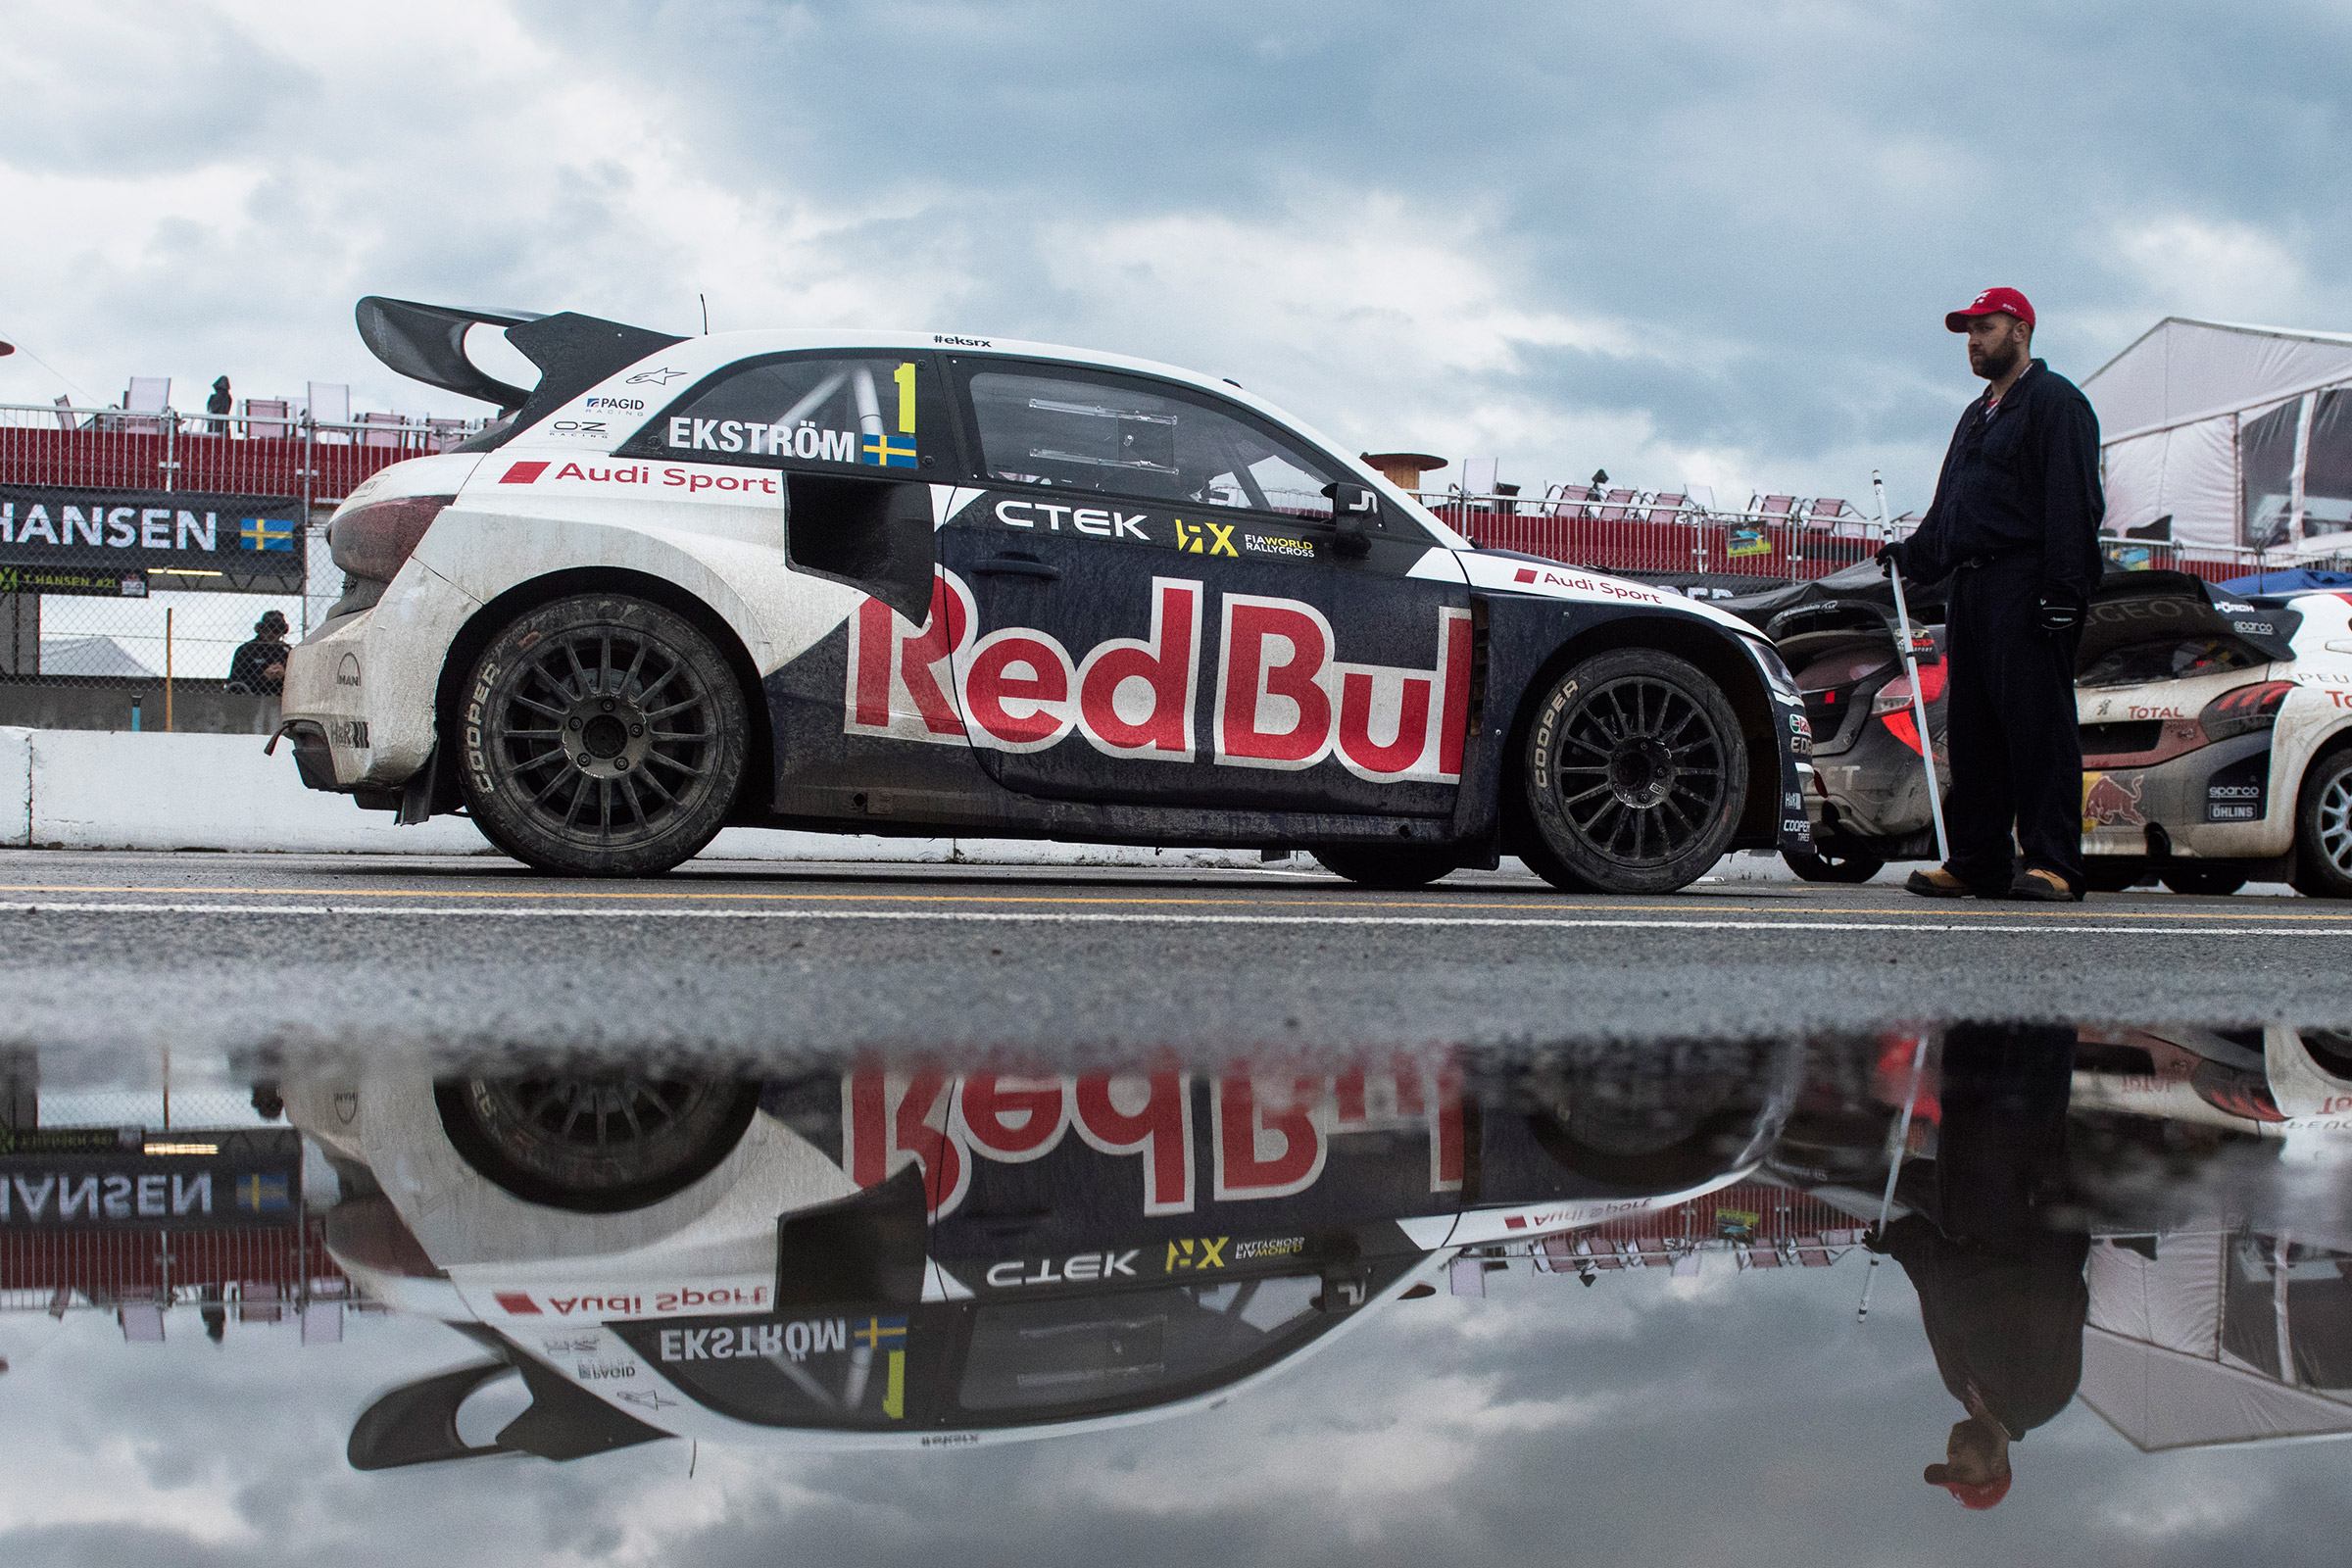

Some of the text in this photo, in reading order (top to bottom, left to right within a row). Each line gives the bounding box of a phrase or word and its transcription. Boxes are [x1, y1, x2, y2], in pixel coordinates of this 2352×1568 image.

[933, 335, 992, 347] #eksrx
[601, 398, 645, 411] PAGID
[894, 362, 916, 433] 1
[668, 416, 856, 463] EKSTRÖM
[555, 462, 777, 494] Audi Sport
[995, 500, 1152, 541] CTEK
[1246, 542, 1315, 558] RALLYCROSS
[1544, 572, 1594, 592] Audi
[1599, 582, 1662, 605] Sport
[2234, 620, 2274, 634] sparco
[338, 675, 359, 686] MAN
[2129, 705, 2184, 719] TOTAL
[466, 662, 502, 794] COOPER
[1533, 679, 1580, 788] COOPER
[2209, 786, 2259, 799] sparco
[2212, 804, 2254, 818] ÖHLINS
[1783, 818, 1811, 833] COOPER
